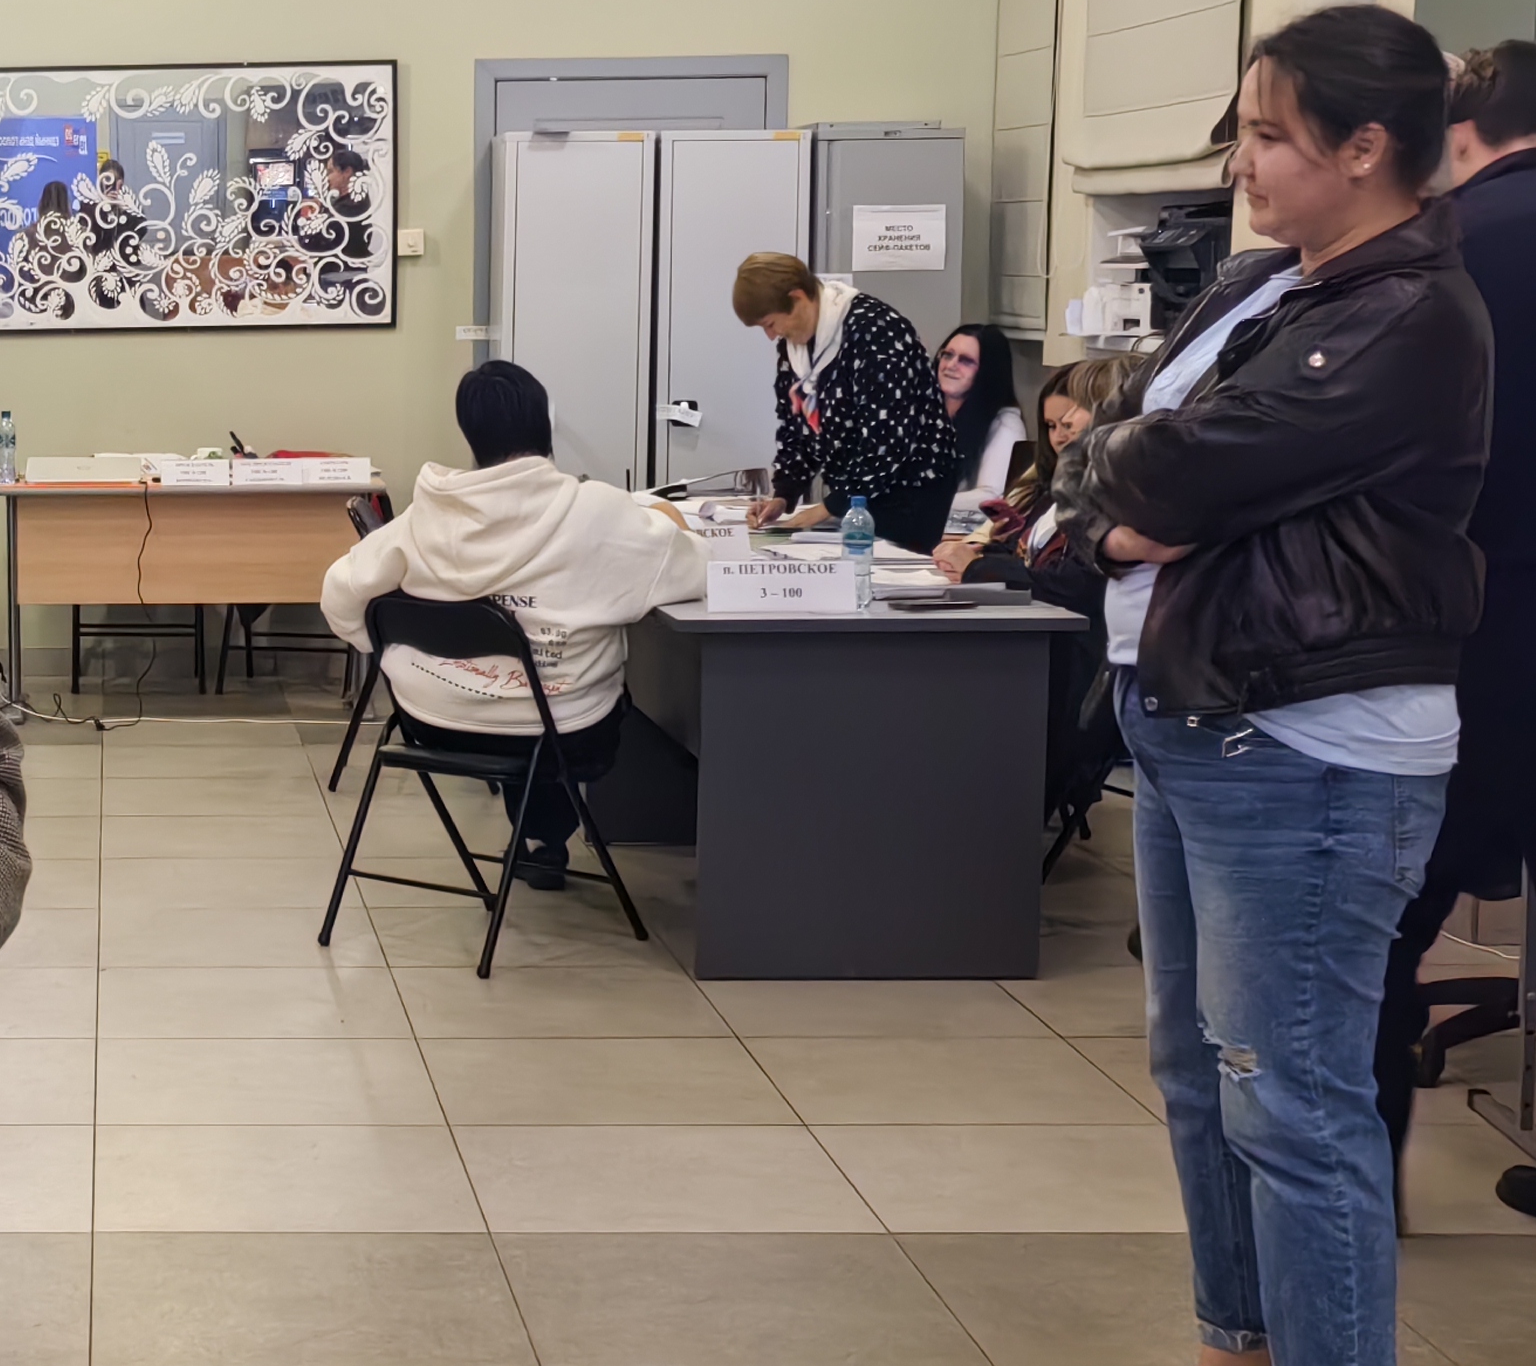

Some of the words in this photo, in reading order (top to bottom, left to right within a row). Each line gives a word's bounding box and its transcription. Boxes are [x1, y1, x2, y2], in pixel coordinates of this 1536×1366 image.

[722, 566, 735, 575] п.
[739, 563, 837, 575] ПЕТРОВСКОЕ
[782, 587, 803, 598] 100
[492, 594, 538, 609] PENSE
